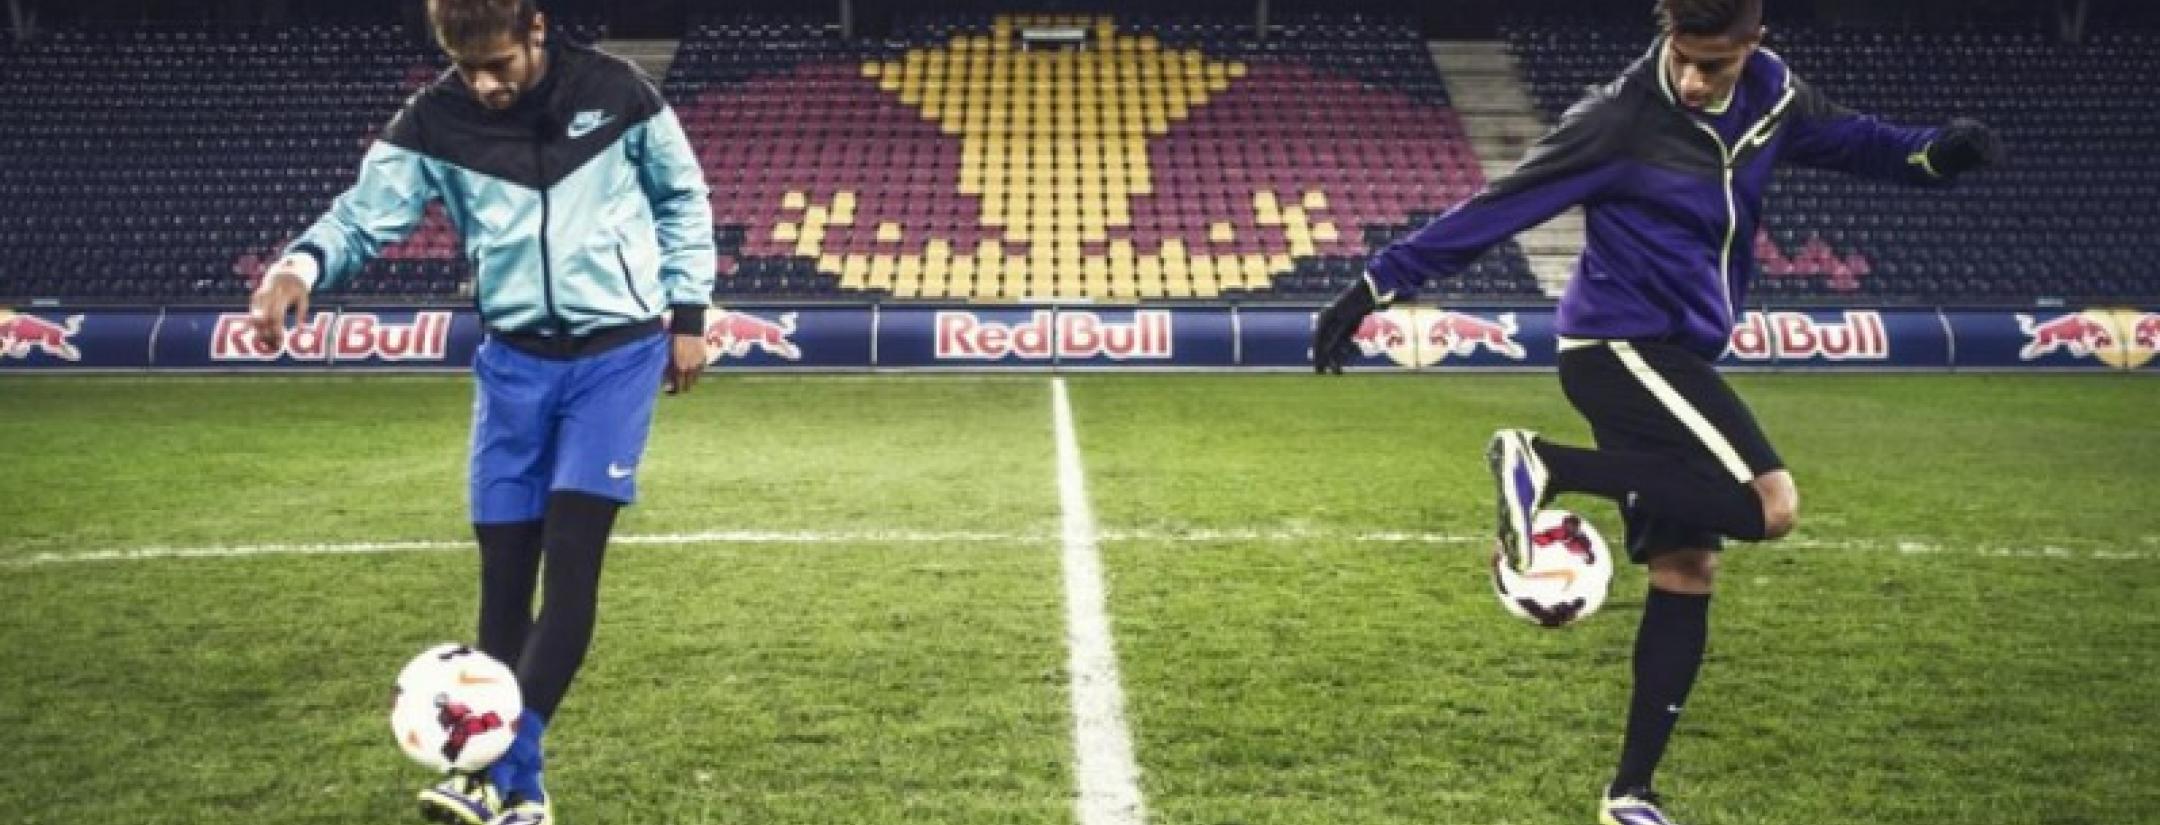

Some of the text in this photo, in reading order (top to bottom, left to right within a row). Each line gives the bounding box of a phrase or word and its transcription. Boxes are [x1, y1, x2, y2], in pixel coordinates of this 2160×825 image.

[336, 312, 451, 360] Bull
[935, 310, 1172, 359] Red Bull
[1773, 311, 1888, 360] Bull
